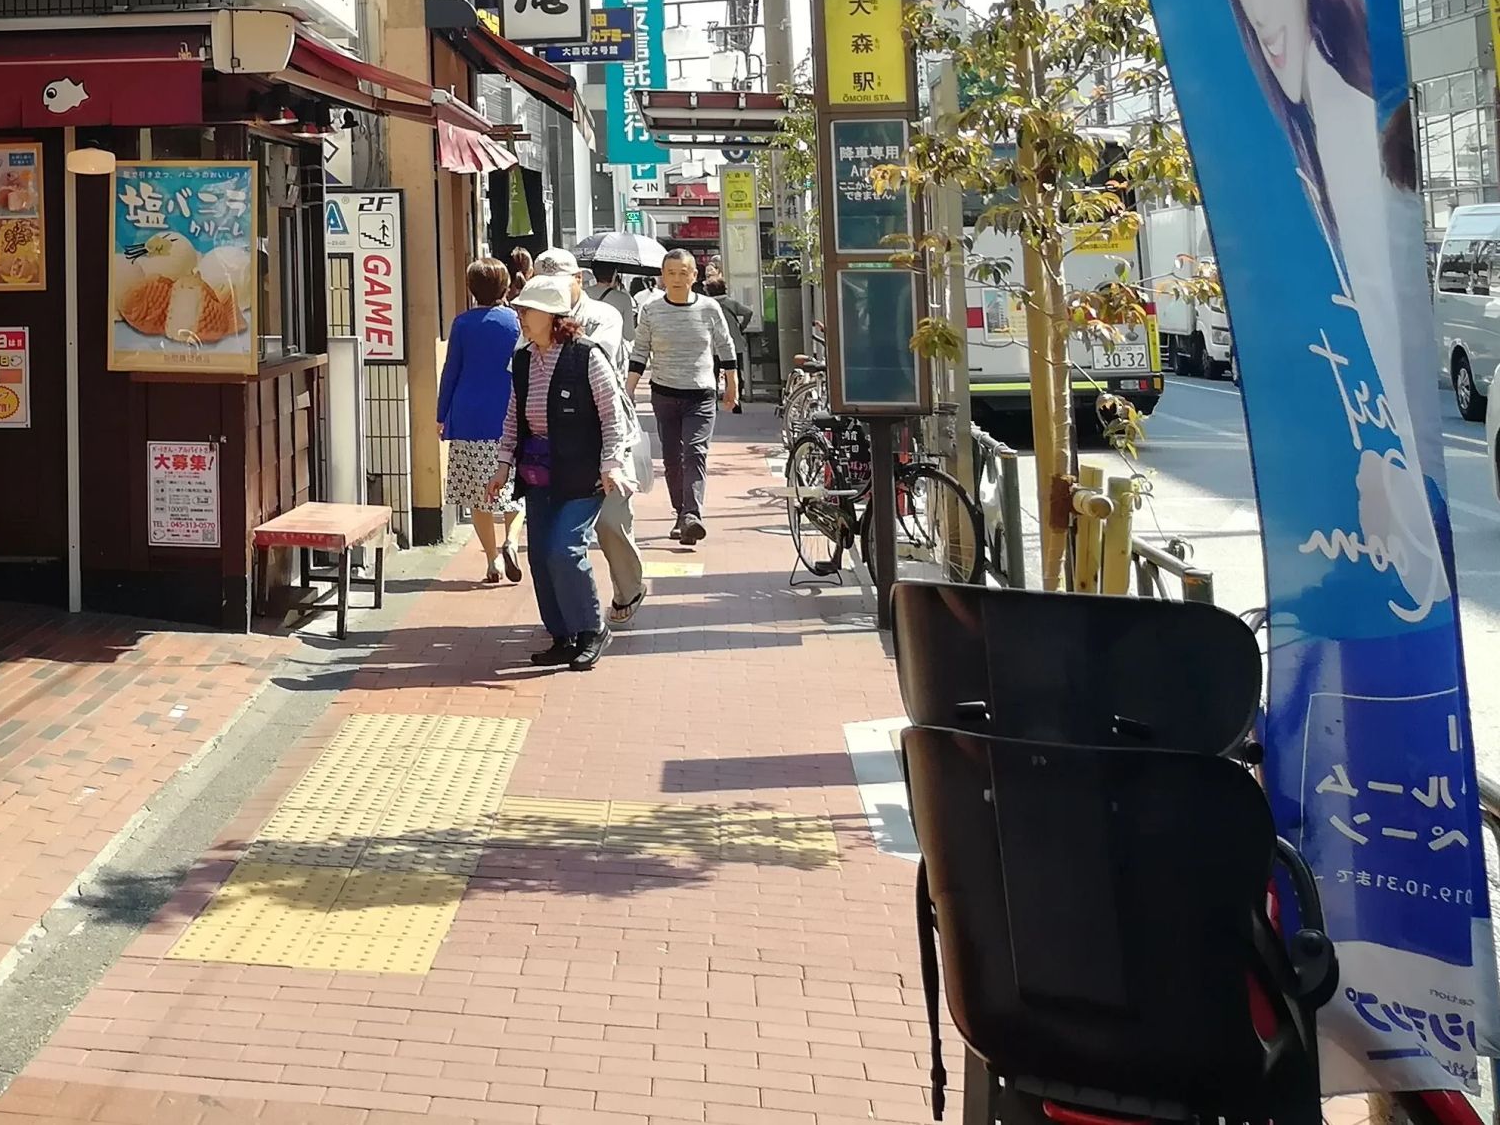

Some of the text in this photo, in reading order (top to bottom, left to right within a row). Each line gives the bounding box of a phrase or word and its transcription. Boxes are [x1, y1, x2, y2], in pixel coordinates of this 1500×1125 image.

[839, 145, 900, 161] 降車専用
[647, 183, 659, 192] IN
[118, 181, 247, 229] 塩バニラ
[358, 196, 394, 212] 2F
[190, 220, 244, 236] クリーム
[362, 254, 393, 347] GAME
[154, 453, 215, 471] 大募集!
